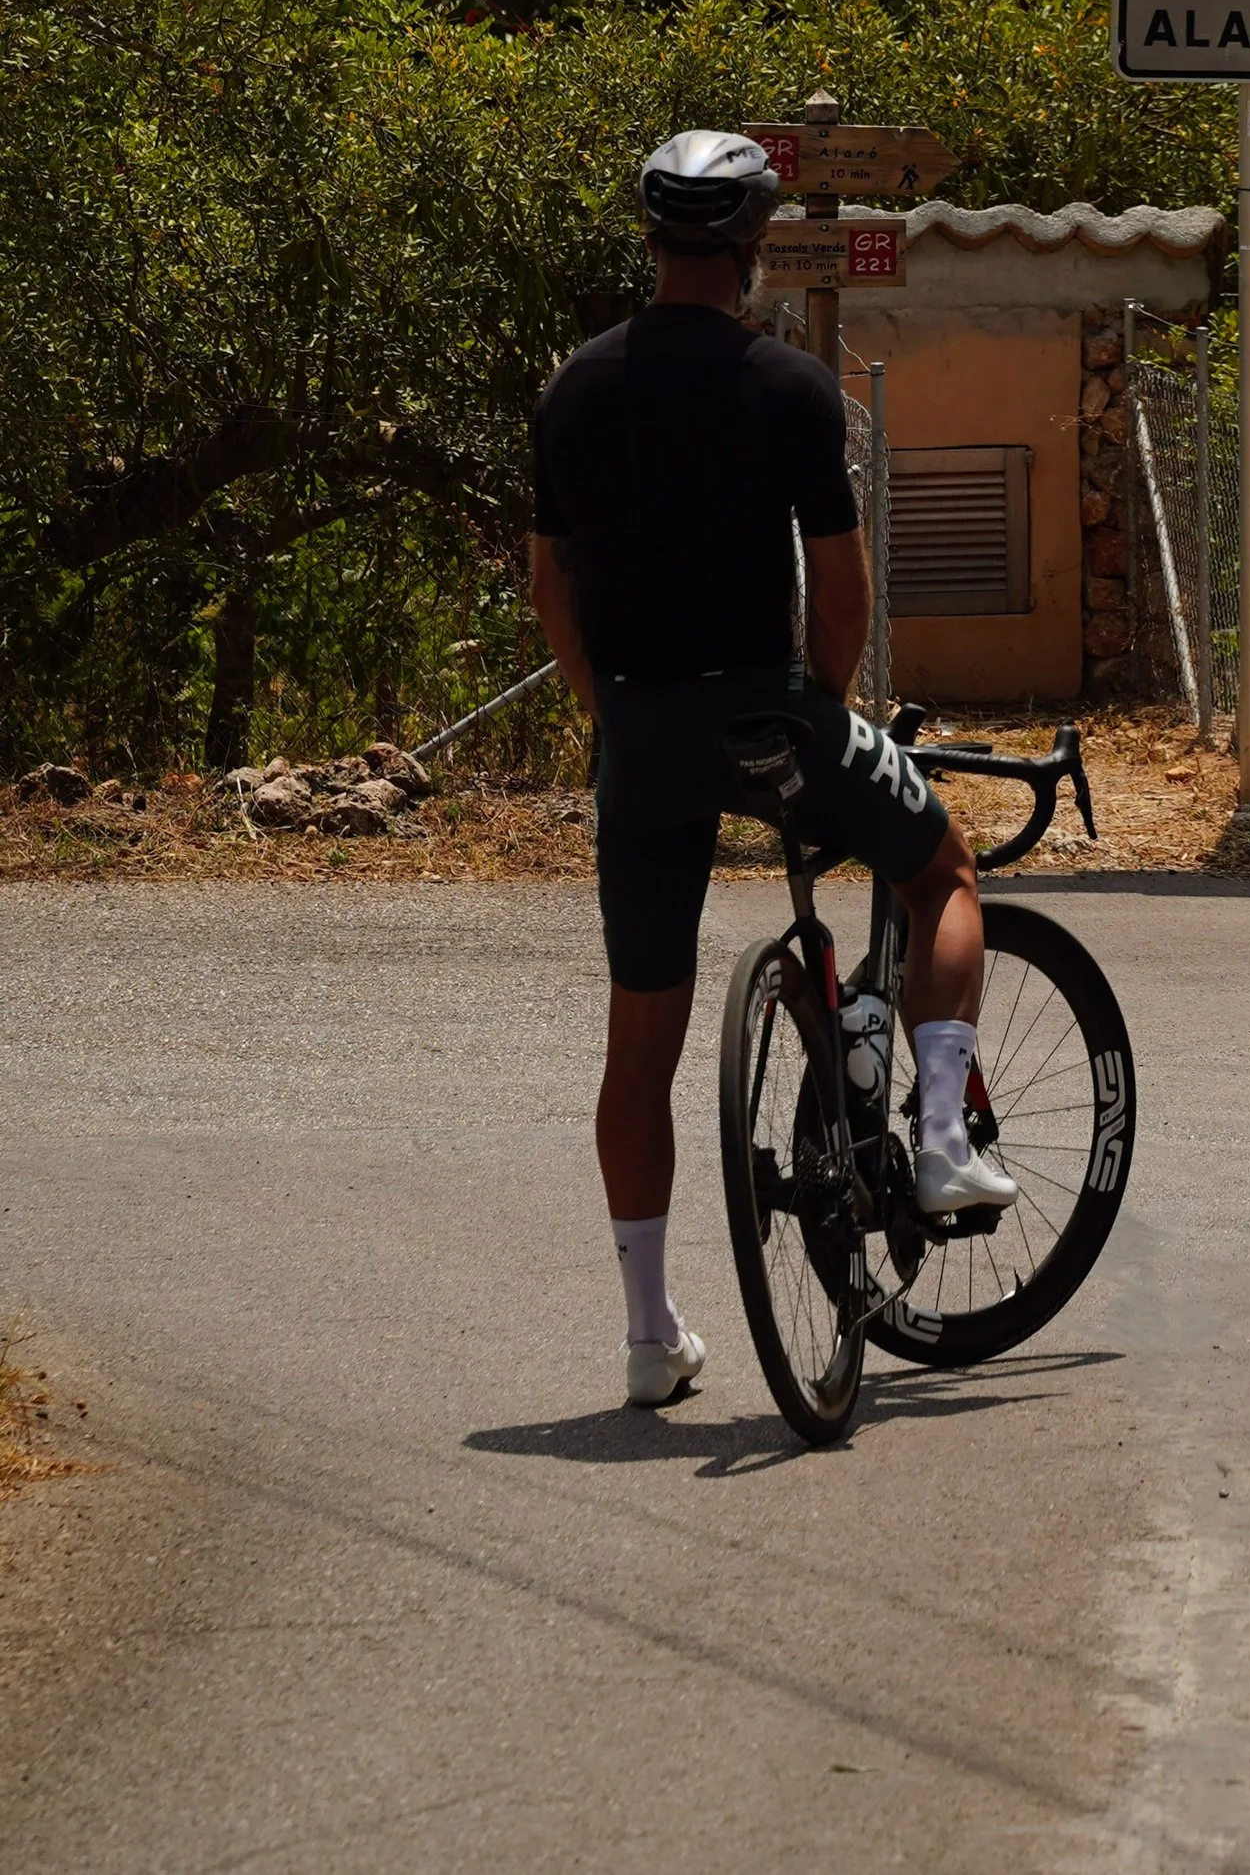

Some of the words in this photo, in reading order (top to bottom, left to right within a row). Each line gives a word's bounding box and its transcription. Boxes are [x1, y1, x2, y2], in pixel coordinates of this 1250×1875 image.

[760, 137, 794, 156] GR
[817, 146, 877, 158] Alaró
[771, 162, 794, 178] 21
[830, 168, 845, 179] 10
[850, 168, 870, 179] min
[766, 243, 808, 254] Tossals
[812, 242, 847, 253] Verds
[854, 233, 892, 251] GR
[770, 260, 777, 270] 2
[783, 260, 790, 270] h
[796, 260, 812, 271] 10
[816, 260, 837, 270] min
[855, 257, 892, 271] 221
[840, 709, 928, 815] PAS
